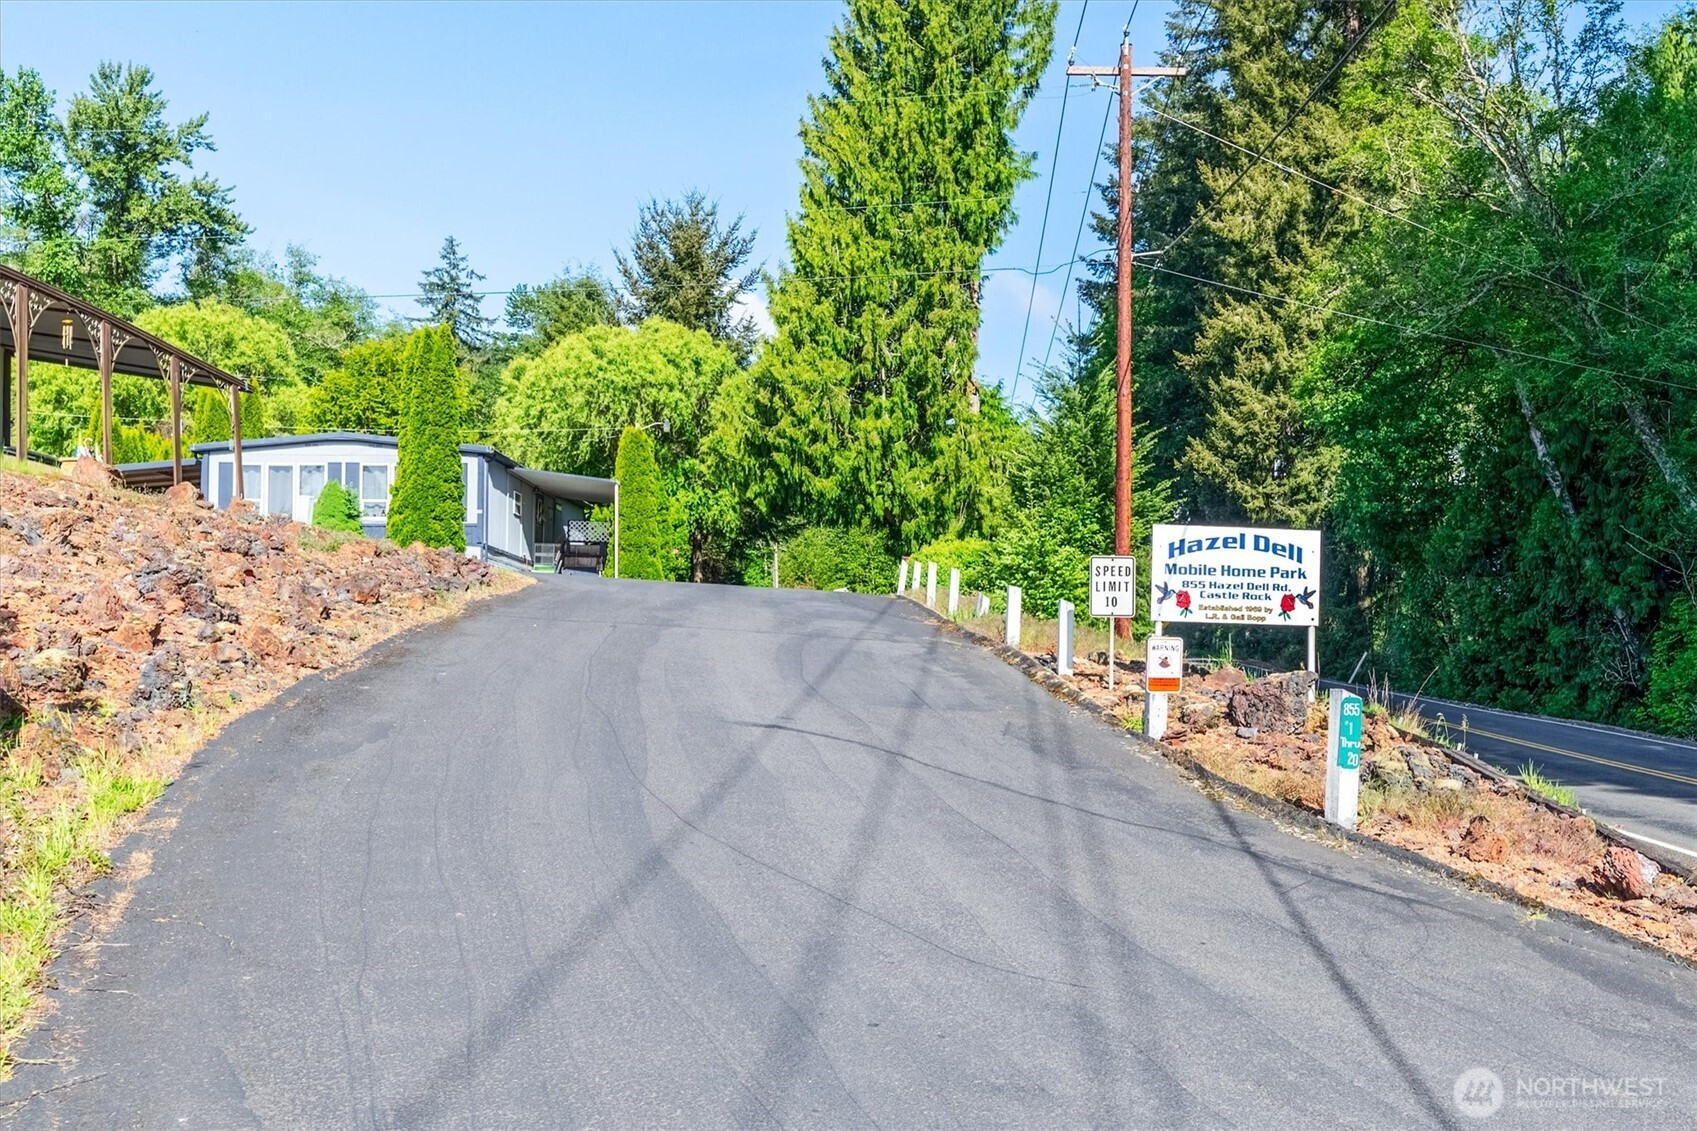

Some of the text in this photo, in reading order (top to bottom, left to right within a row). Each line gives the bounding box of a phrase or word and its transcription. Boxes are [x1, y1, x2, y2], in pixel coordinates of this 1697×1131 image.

[1168, 533, 1303, 564] Hazel Dell
[1095, 565, 1131, 577] SPEED
[1164, 563, 1307, 579] Mobile Home Park
[1095, 581, 1130, 592] LIMIT
[1182, 580, 1292, 592] 855 Hazel Dell Rd.
[1200, 590, 1272, 601] Castle Rock
[1105, 596, 1118, 608] 10
[1198, 604, 1243, 612] Established
[1264, 606, 1274, 614] by
[1343, 703, 1360, 716] 855
[1340, 736, 1361, 749] Thru
[1347, 752, 1359, 766] 20
